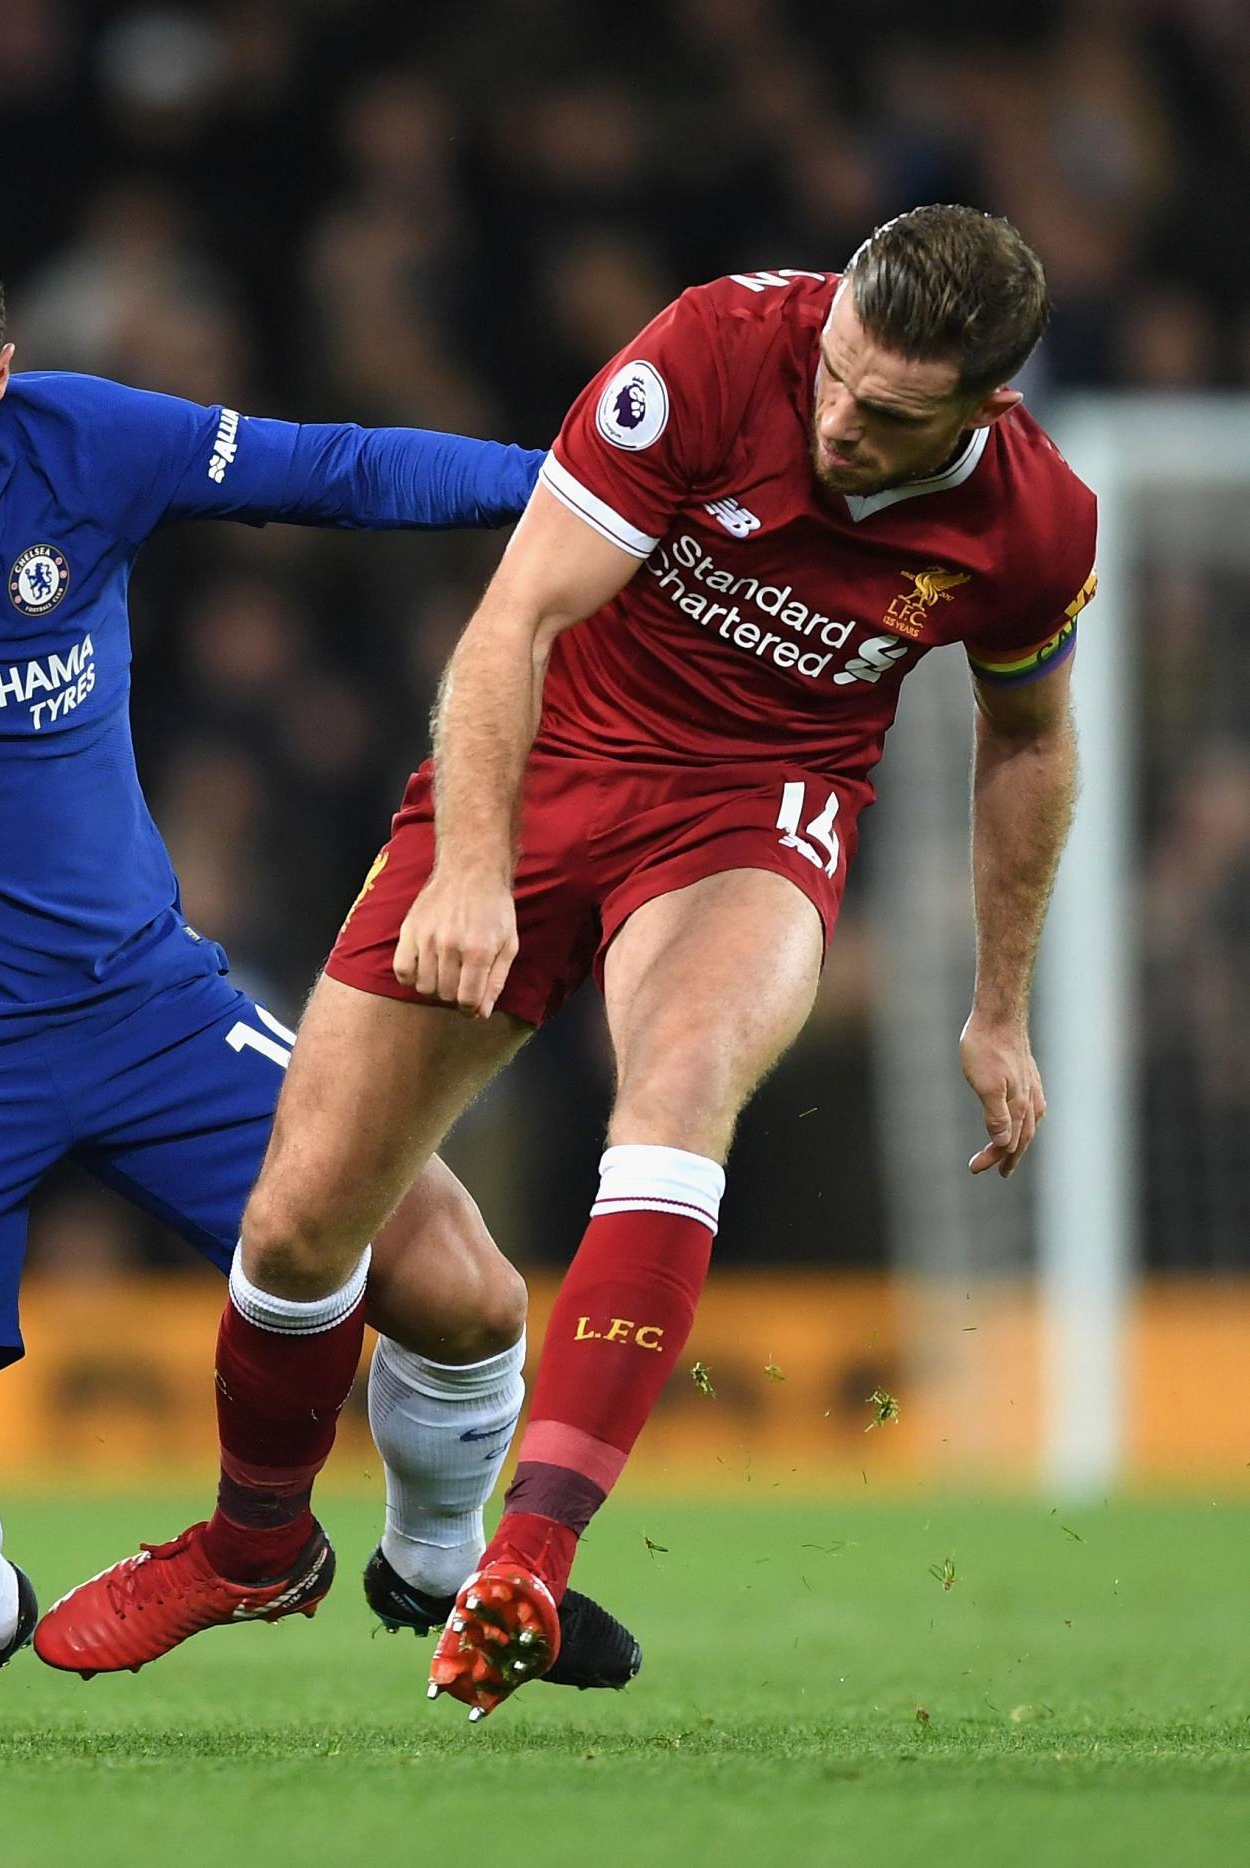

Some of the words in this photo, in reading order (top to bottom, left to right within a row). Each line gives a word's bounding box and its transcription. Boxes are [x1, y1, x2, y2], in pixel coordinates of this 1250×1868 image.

[14, 546, 51, 574] CHELSEA
[672, 535, 856, 649] Standard
[646, 545, 833, 678] Chartered
[895, 620, 920, 637] YEARS
[29, 662, 95, 730] TYRES
[776, 782, 840, 879] 14
[573, 1316, 664, 1352] L.F.C.
